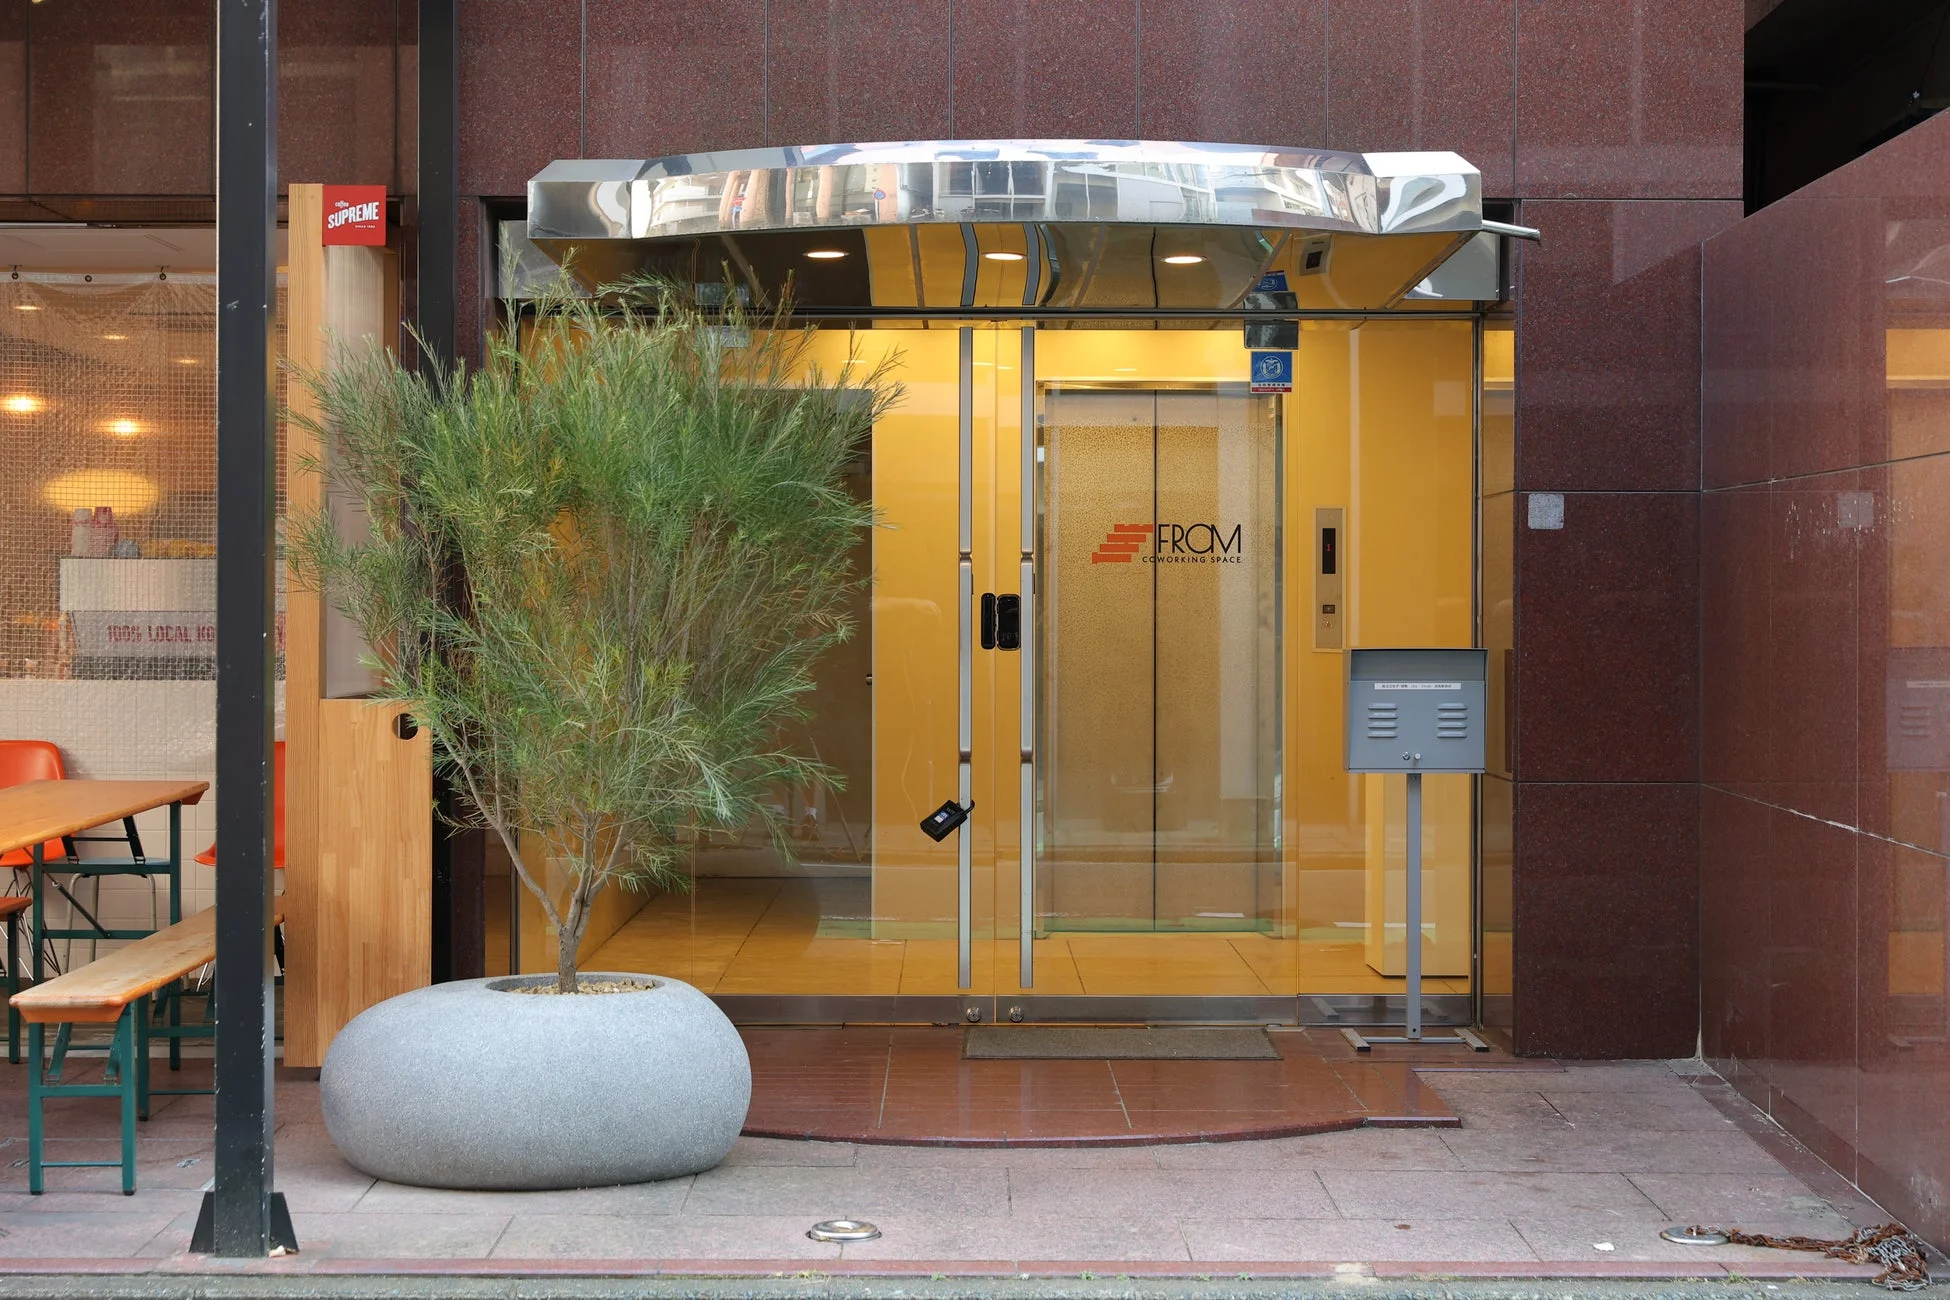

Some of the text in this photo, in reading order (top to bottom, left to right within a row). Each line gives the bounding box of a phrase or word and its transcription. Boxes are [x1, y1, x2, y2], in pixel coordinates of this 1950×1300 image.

[335, 200, 349, 208] coffee
[327, 201, 380, 229] SUPREME
[107, 625, 142, 642] 100%
[148, 625, 191, 642] LOCAL
